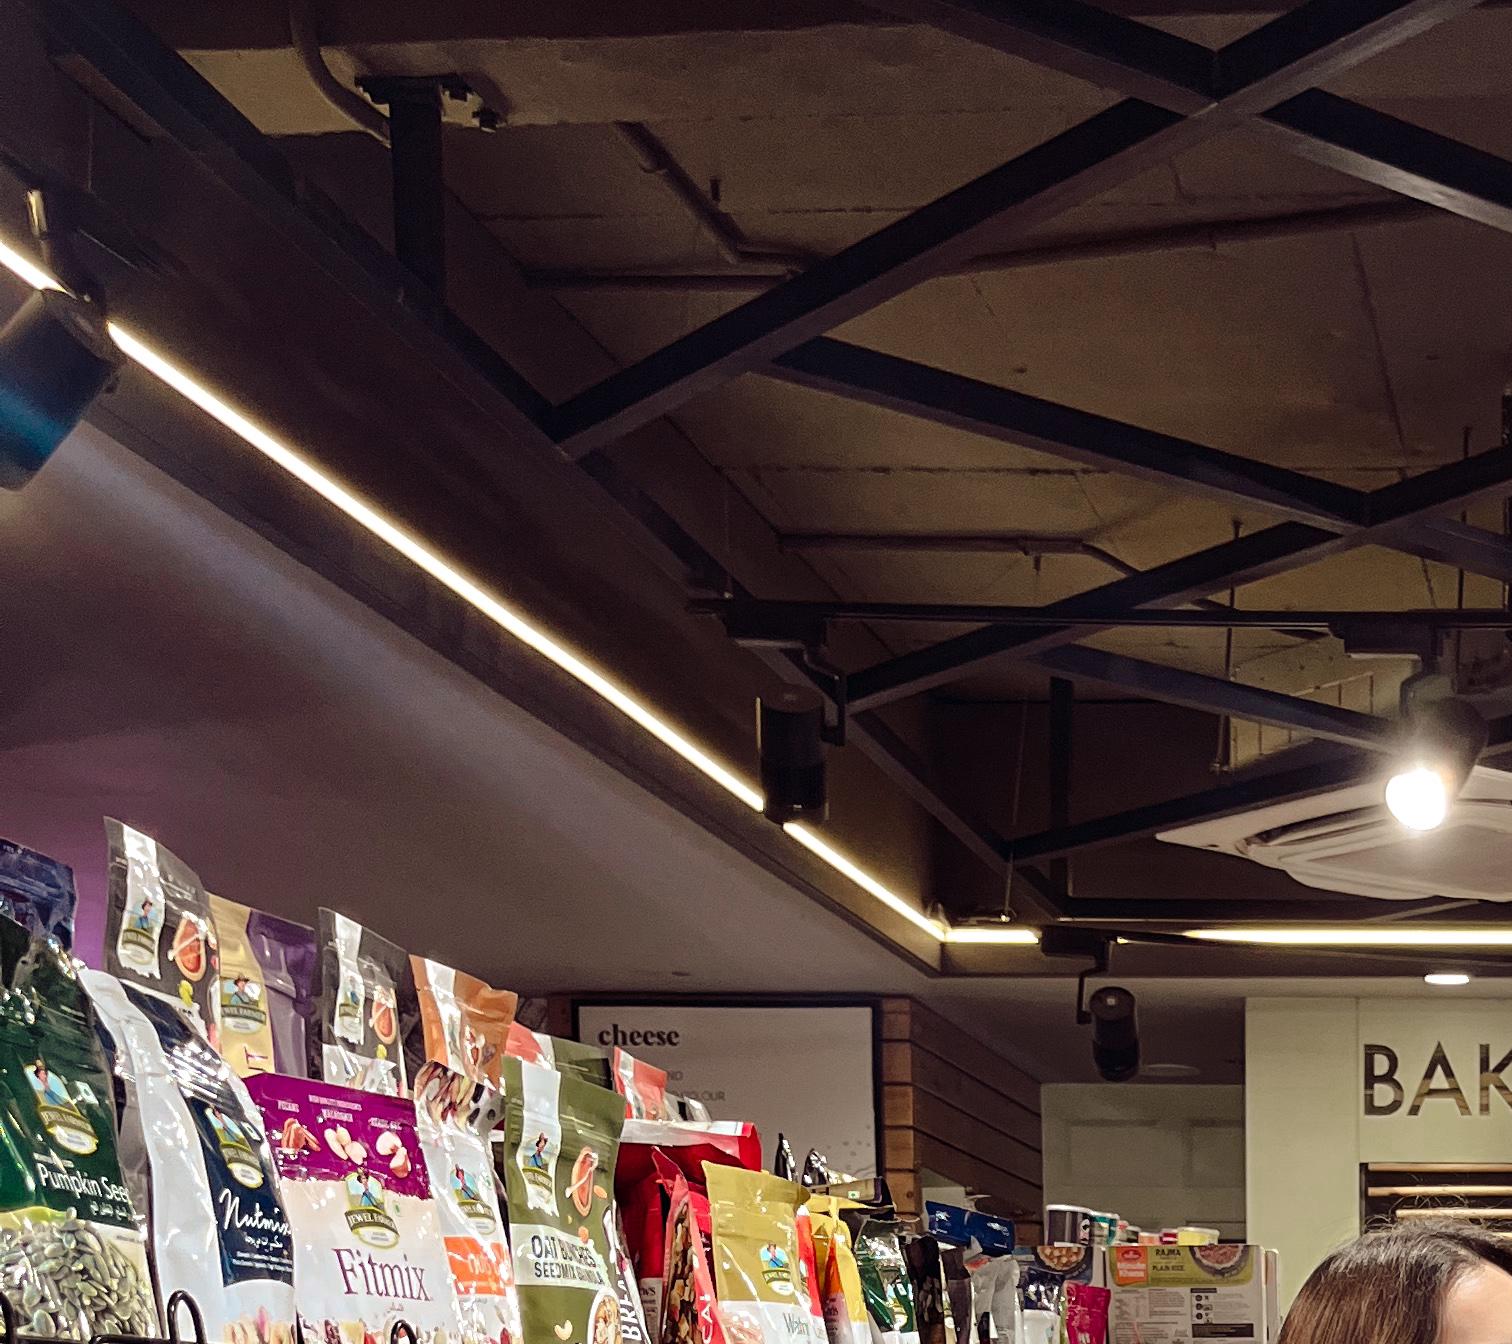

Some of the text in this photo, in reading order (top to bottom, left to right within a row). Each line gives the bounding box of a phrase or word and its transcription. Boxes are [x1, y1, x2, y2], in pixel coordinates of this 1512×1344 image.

[597, 1024, 680, 1047] cheese
[38, 1163, 102, 1200] Pumpkin
[1155, 1248, 1181, 1257] RAJMA
[332, 1248, 433, 1302] Fitmix
